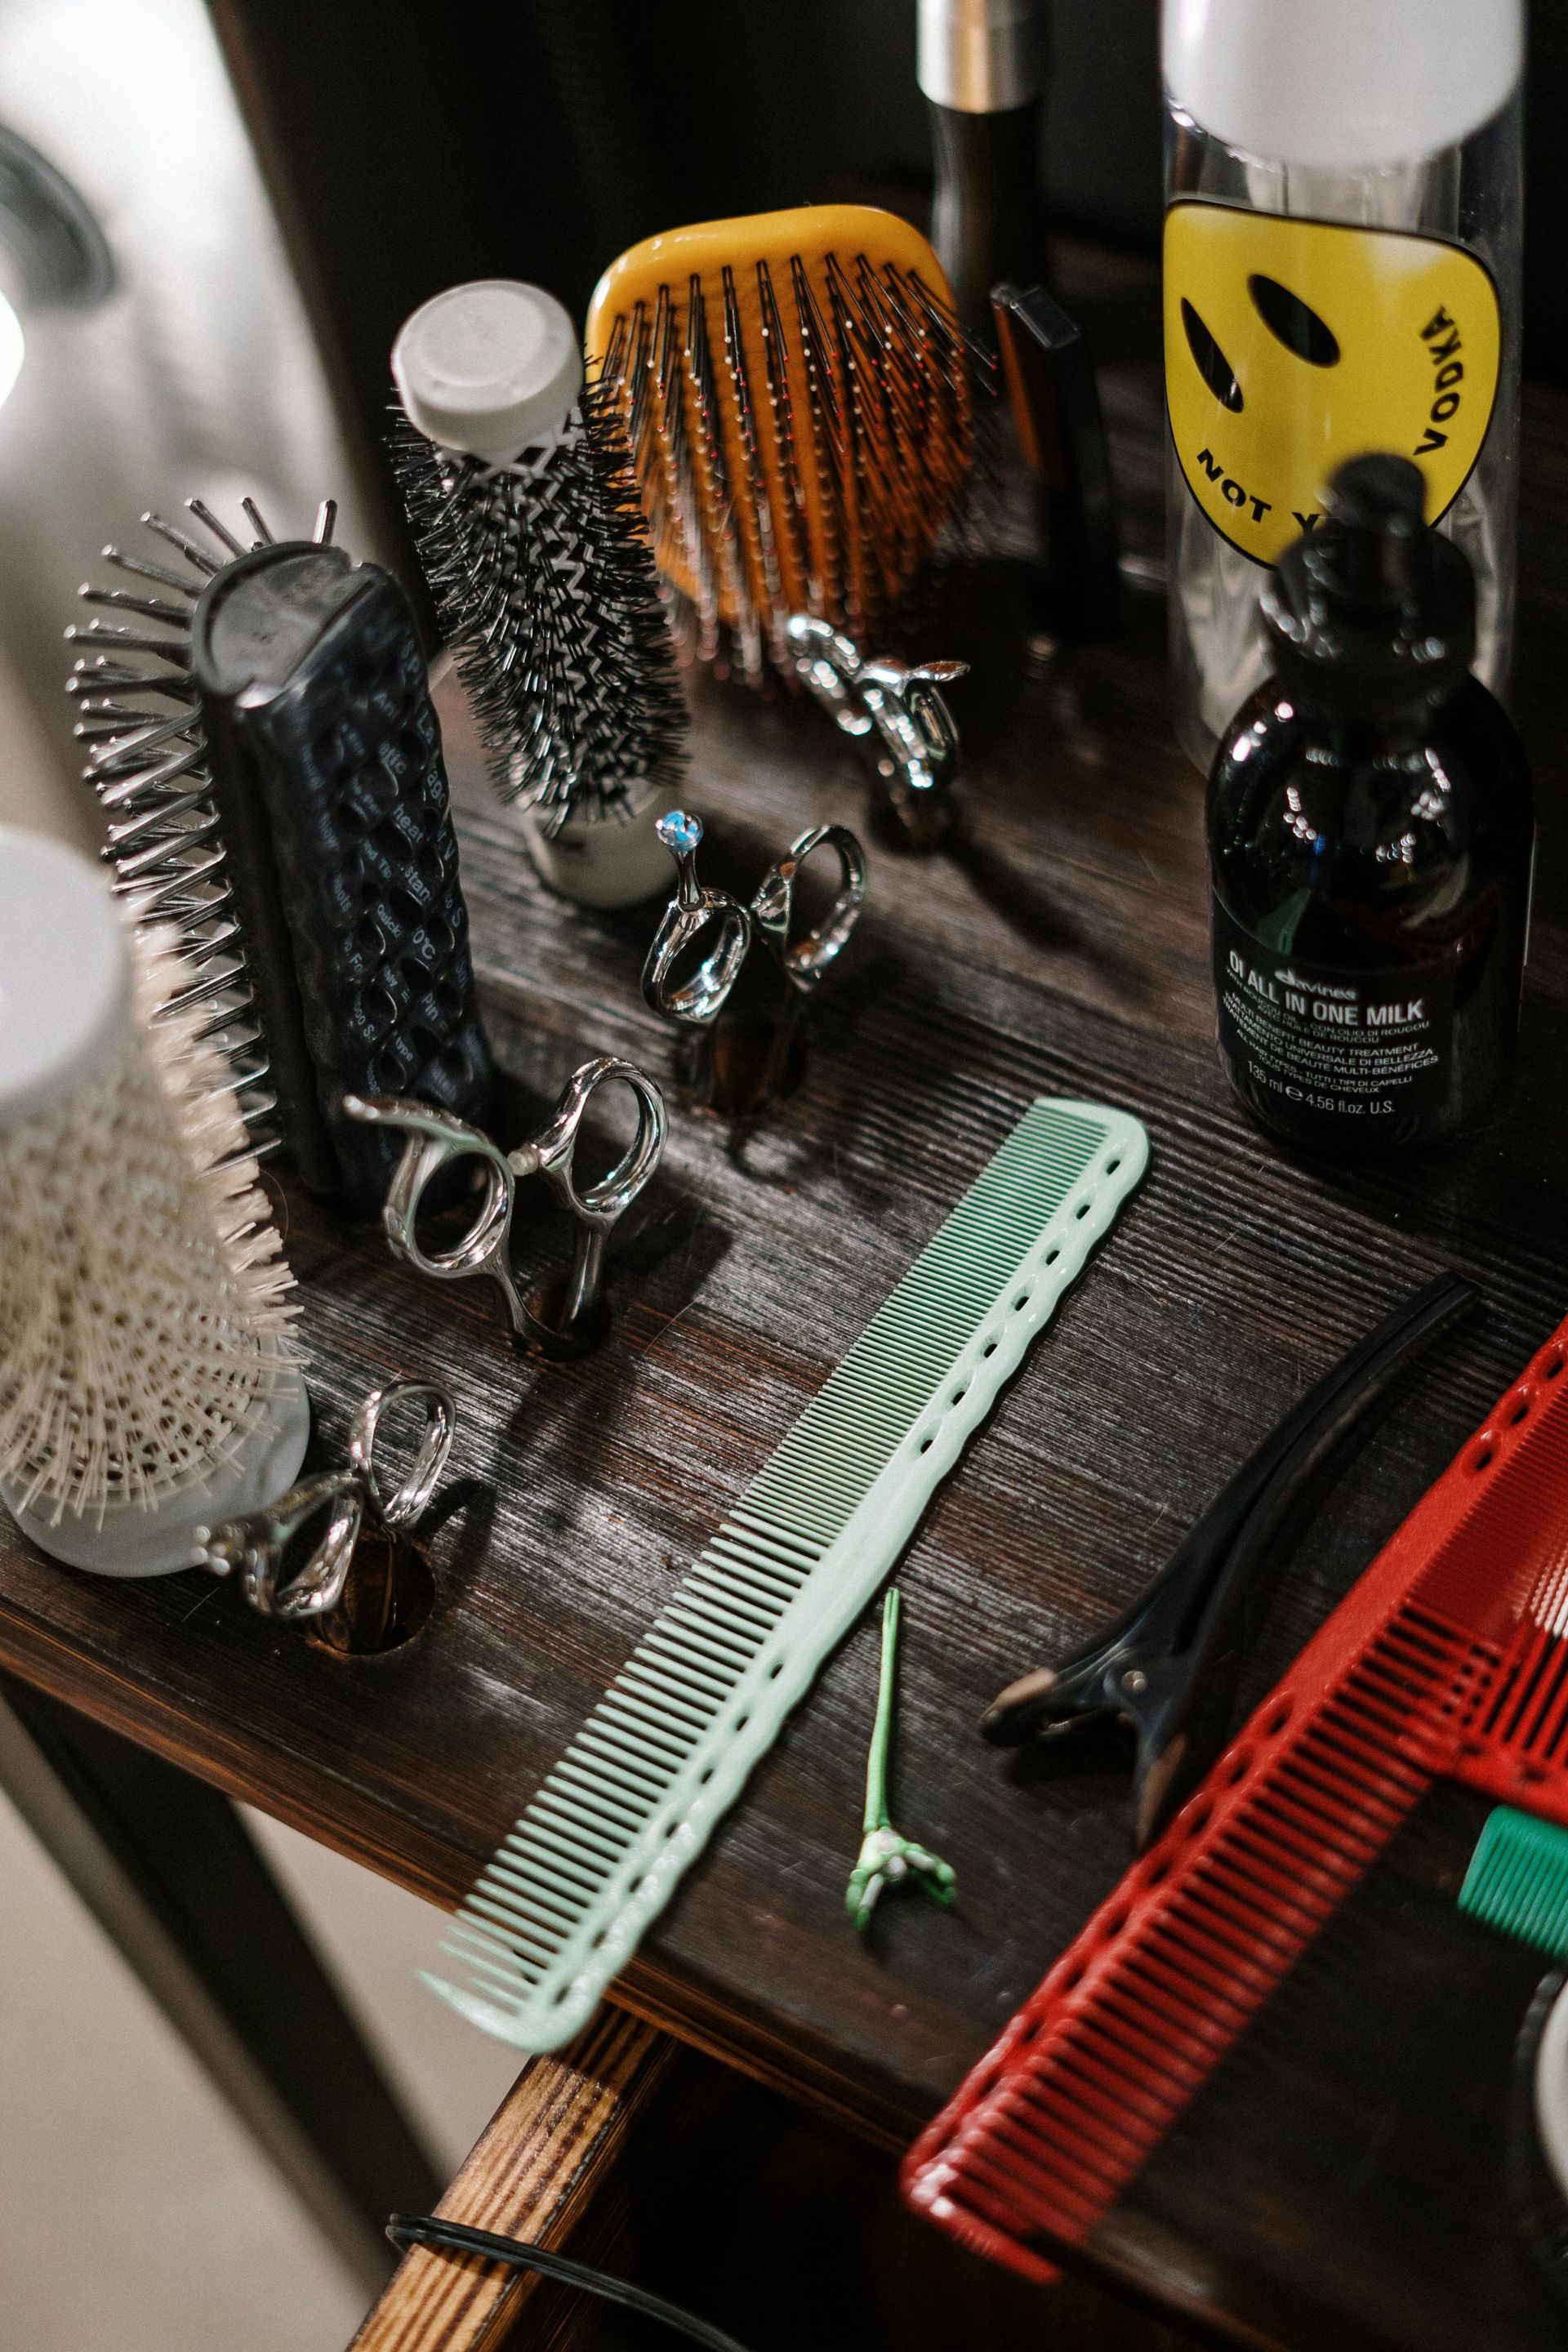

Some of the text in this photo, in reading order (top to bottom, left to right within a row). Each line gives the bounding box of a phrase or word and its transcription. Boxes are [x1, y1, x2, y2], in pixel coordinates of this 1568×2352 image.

[1414, 304, 1463, 456] VODKA
[1197, 448, 1272, 523] NOT
[1229, 950, 1424, 1026] DI ALL IN ONE MILK
[1255, 1015, 1296, 1041] BENEFIT
[1298, 1038, 1345, 1055] BEAUTY
[1349, 1042, 1419, 1057] TREATMENT
[1310, 1022, 1334, 1034] CON
[1338, 1028, 1364, 1037] OLIO
[1366, 1028, 1379, 1036] DI
[1312, 1031, 1327, 1040] DE
[1258, 1054, 1379, 1094] TOUS TYPES DE CHEVEUX
[1270, 1044, 1285, 1056] DE
[1286, 1052, 1331, 1071] BEAUTÉ
[1270, 1055, 1297, 1071] TYPES
[1305, 1071, 1331, 1084] TUTTI
[1357, 1079, 1369, 1087] DI
[1370, 1076, 1412, 1087] CAPELLI
[1285, 1042, 1356, 1065] UNIVERSALE
[1359, 1058, 1371, 1066] DI
[1374, 1048, 1434, 1065] BELLEZZA
[1247, 1060, 1267, 1084] 135
[1269, 1080, 1283, 1094] ml
[1305, 1094, 1334, 1111] 4.56
[1370, 1100, 1395, 1115] U.S.
